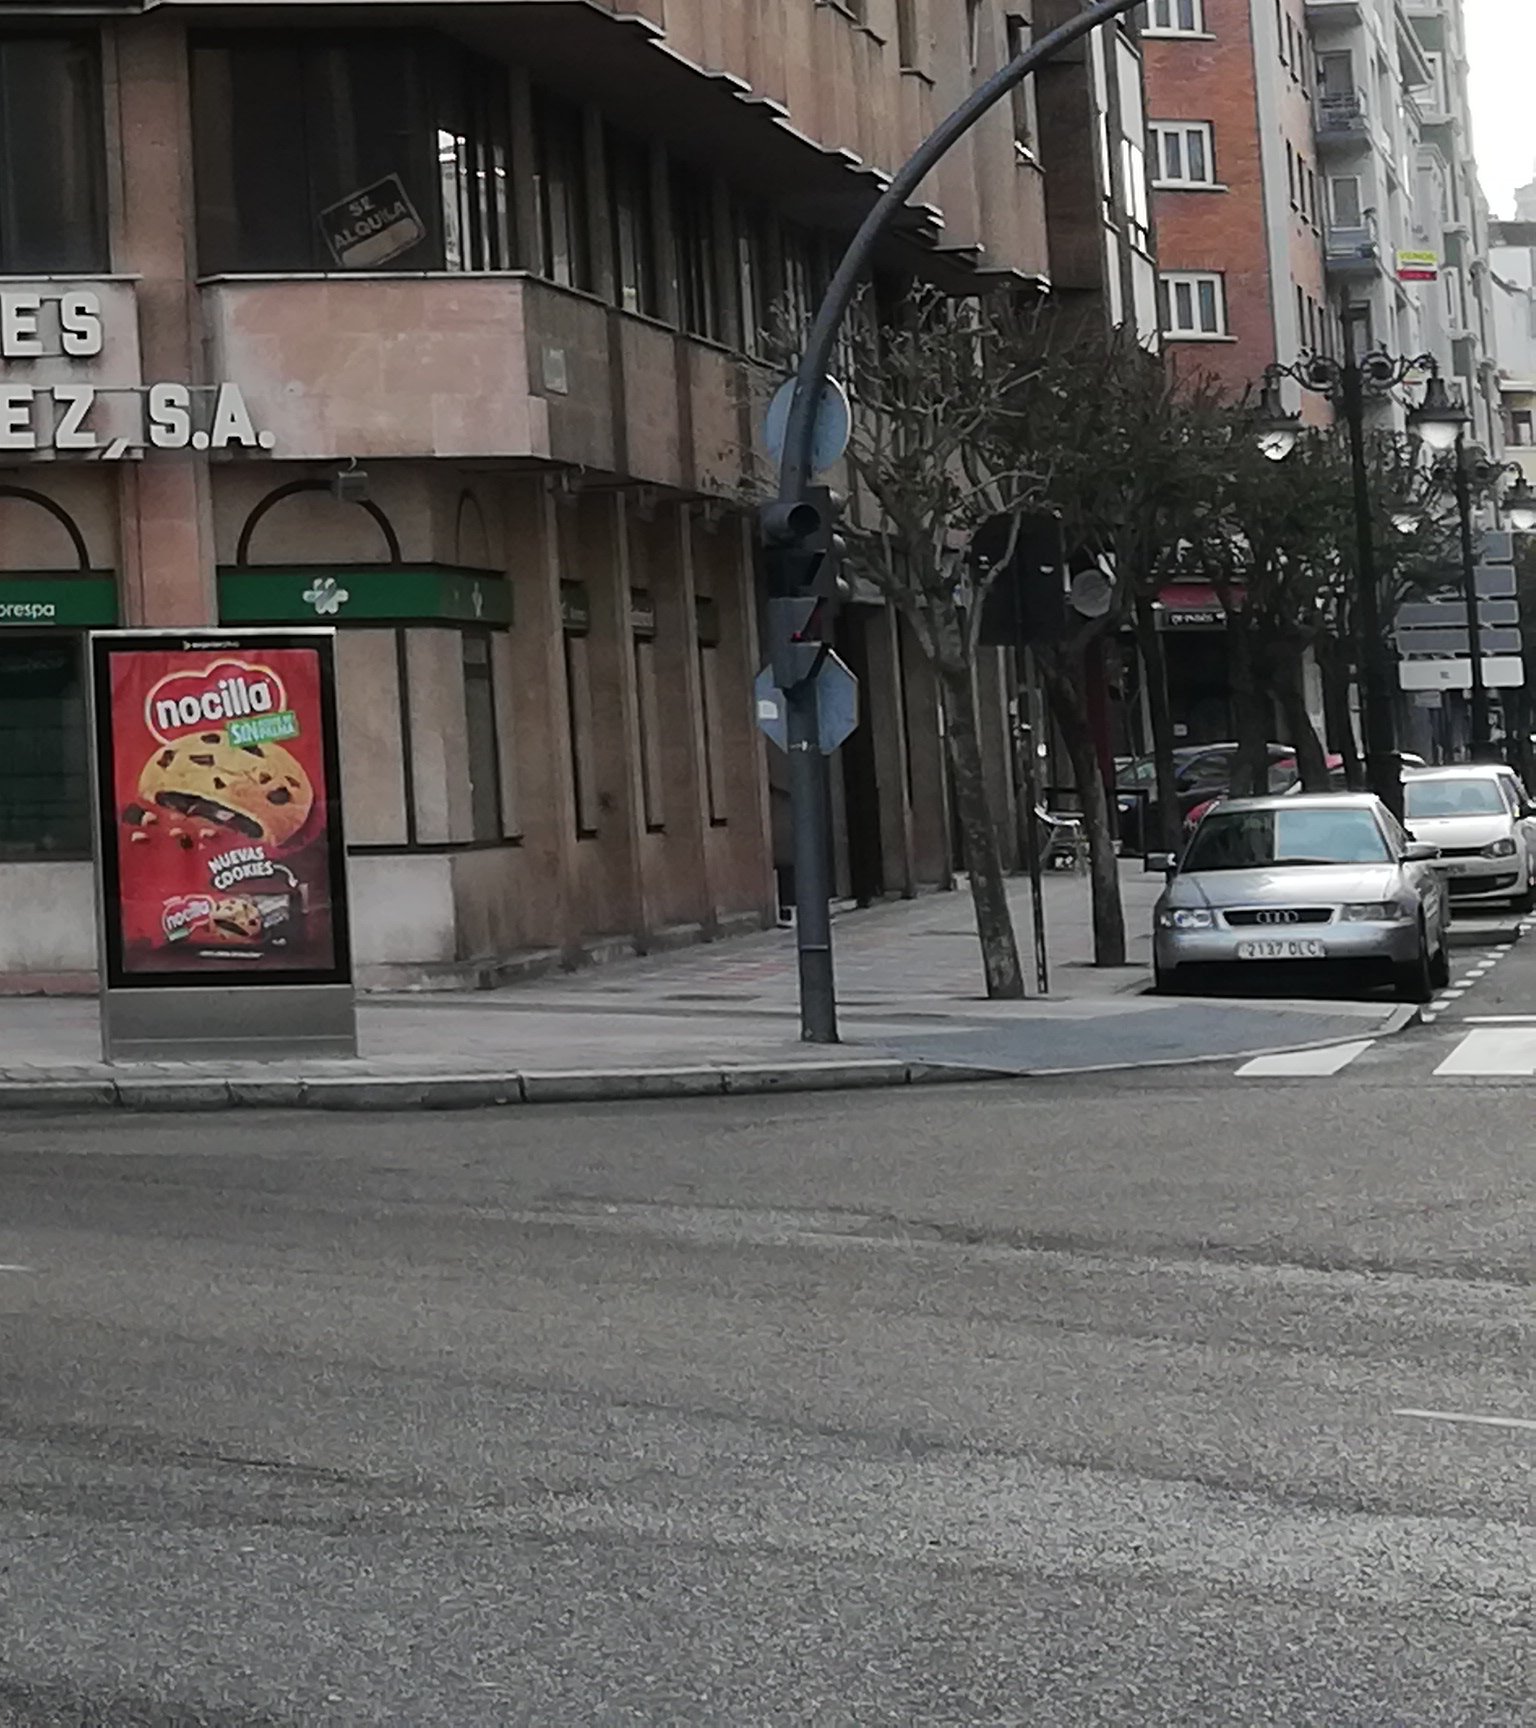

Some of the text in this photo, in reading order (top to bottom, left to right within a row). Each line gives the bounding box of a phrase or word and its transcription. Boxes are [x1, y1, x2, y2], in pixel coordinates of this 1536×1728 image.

[349, 195, 376, 217] SE
[156, 677, 272, 729] nocilla
[208, 846, 264, 874] NUEVAS
[214, 860, 274, 889] COOKIES
